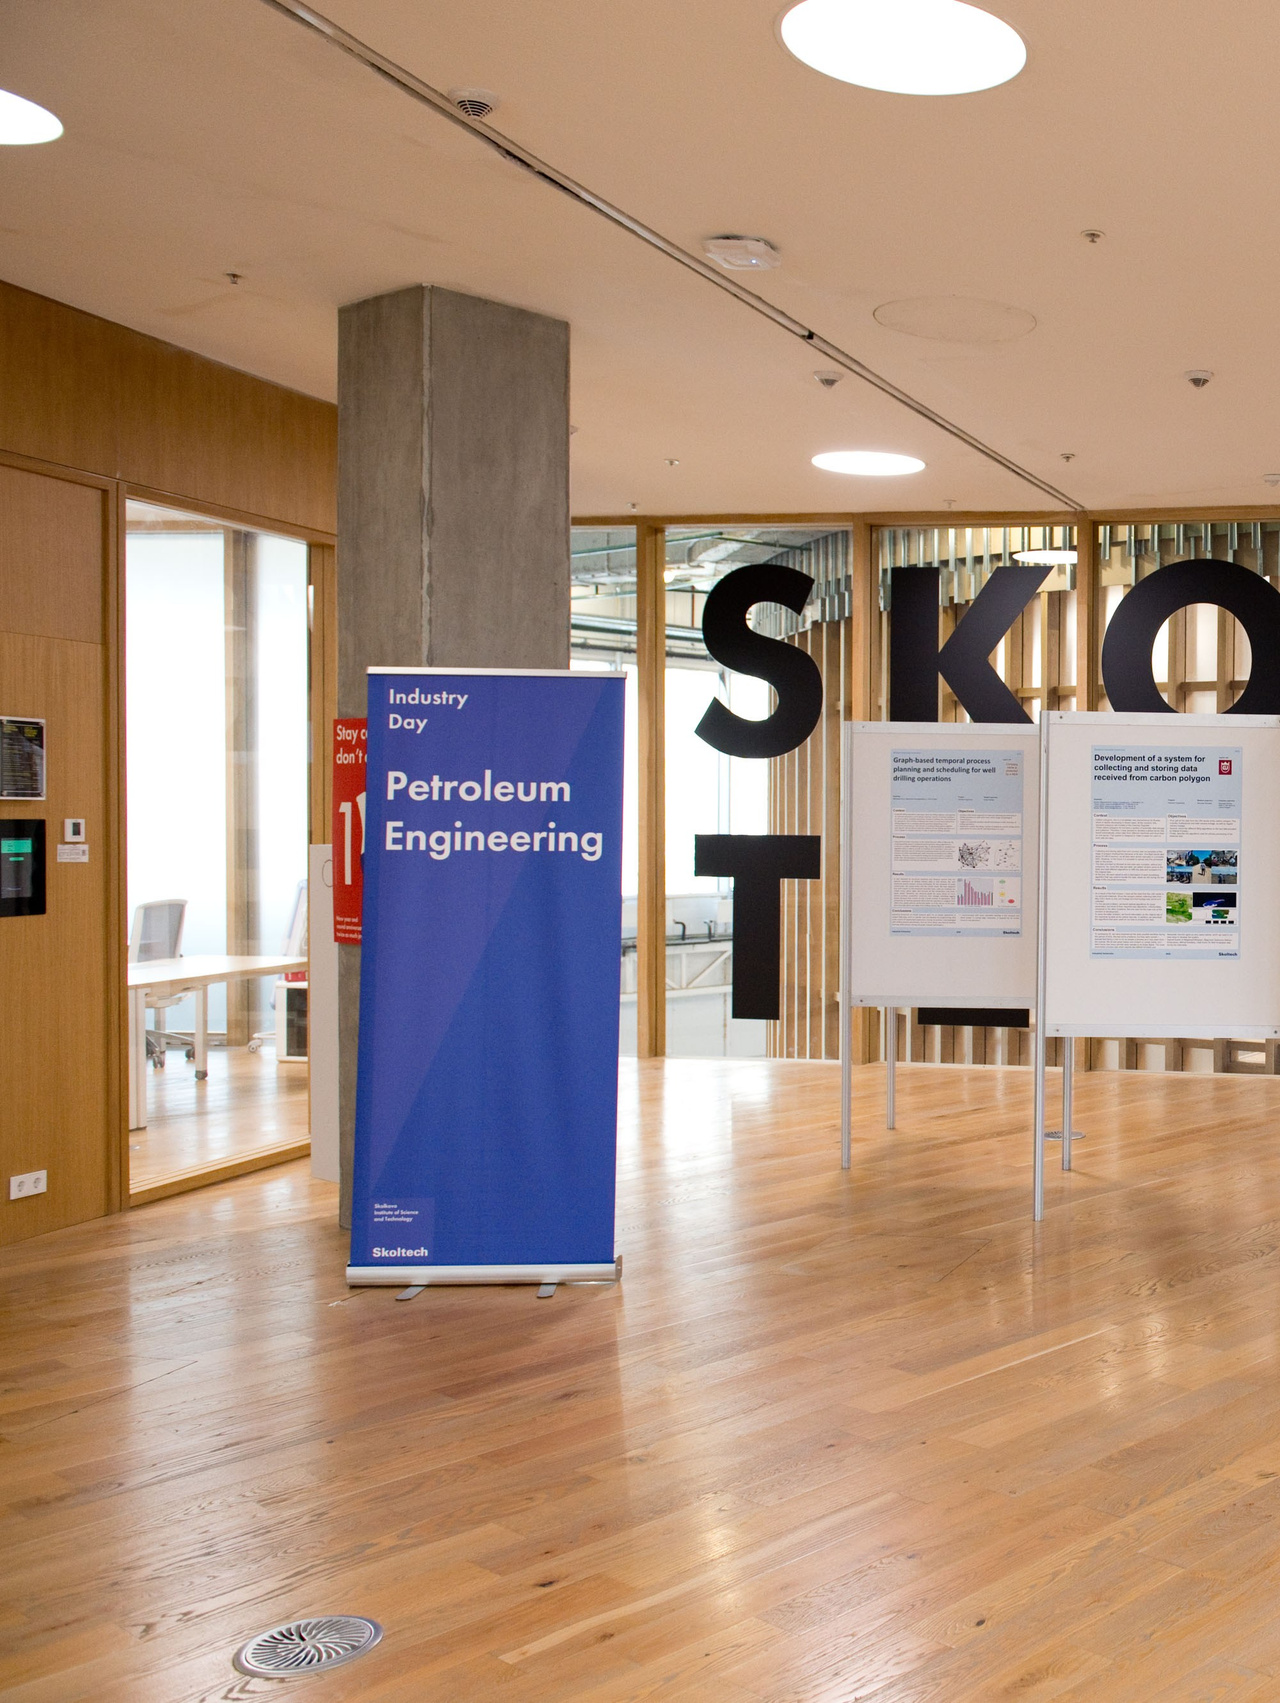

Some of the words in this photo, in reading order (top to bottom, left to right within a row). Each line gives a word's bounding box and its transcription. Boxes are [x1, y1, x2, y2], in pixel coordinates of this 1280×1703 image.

[388, 688, 468, 710] Industry
[388, 714, 428, 734] Day
[336, 724, 358, 745] Stay
[893, 757, 934, 765] Graph-based
[936, 758, 965, 766] temporal
[1094, 754, 1145, 763] Development
[1164, 756, 1192, 764] system
[1094, 764, 1132, 773] collecting
[1151, 765, 1178, 773] storing
[386, 769, 571, 802] Petroleum
[1179, 775, 1210, 783] polygon
[385, 821, 602, 862] Engineering
[372, 1247, 428, 1257] Skoltech
